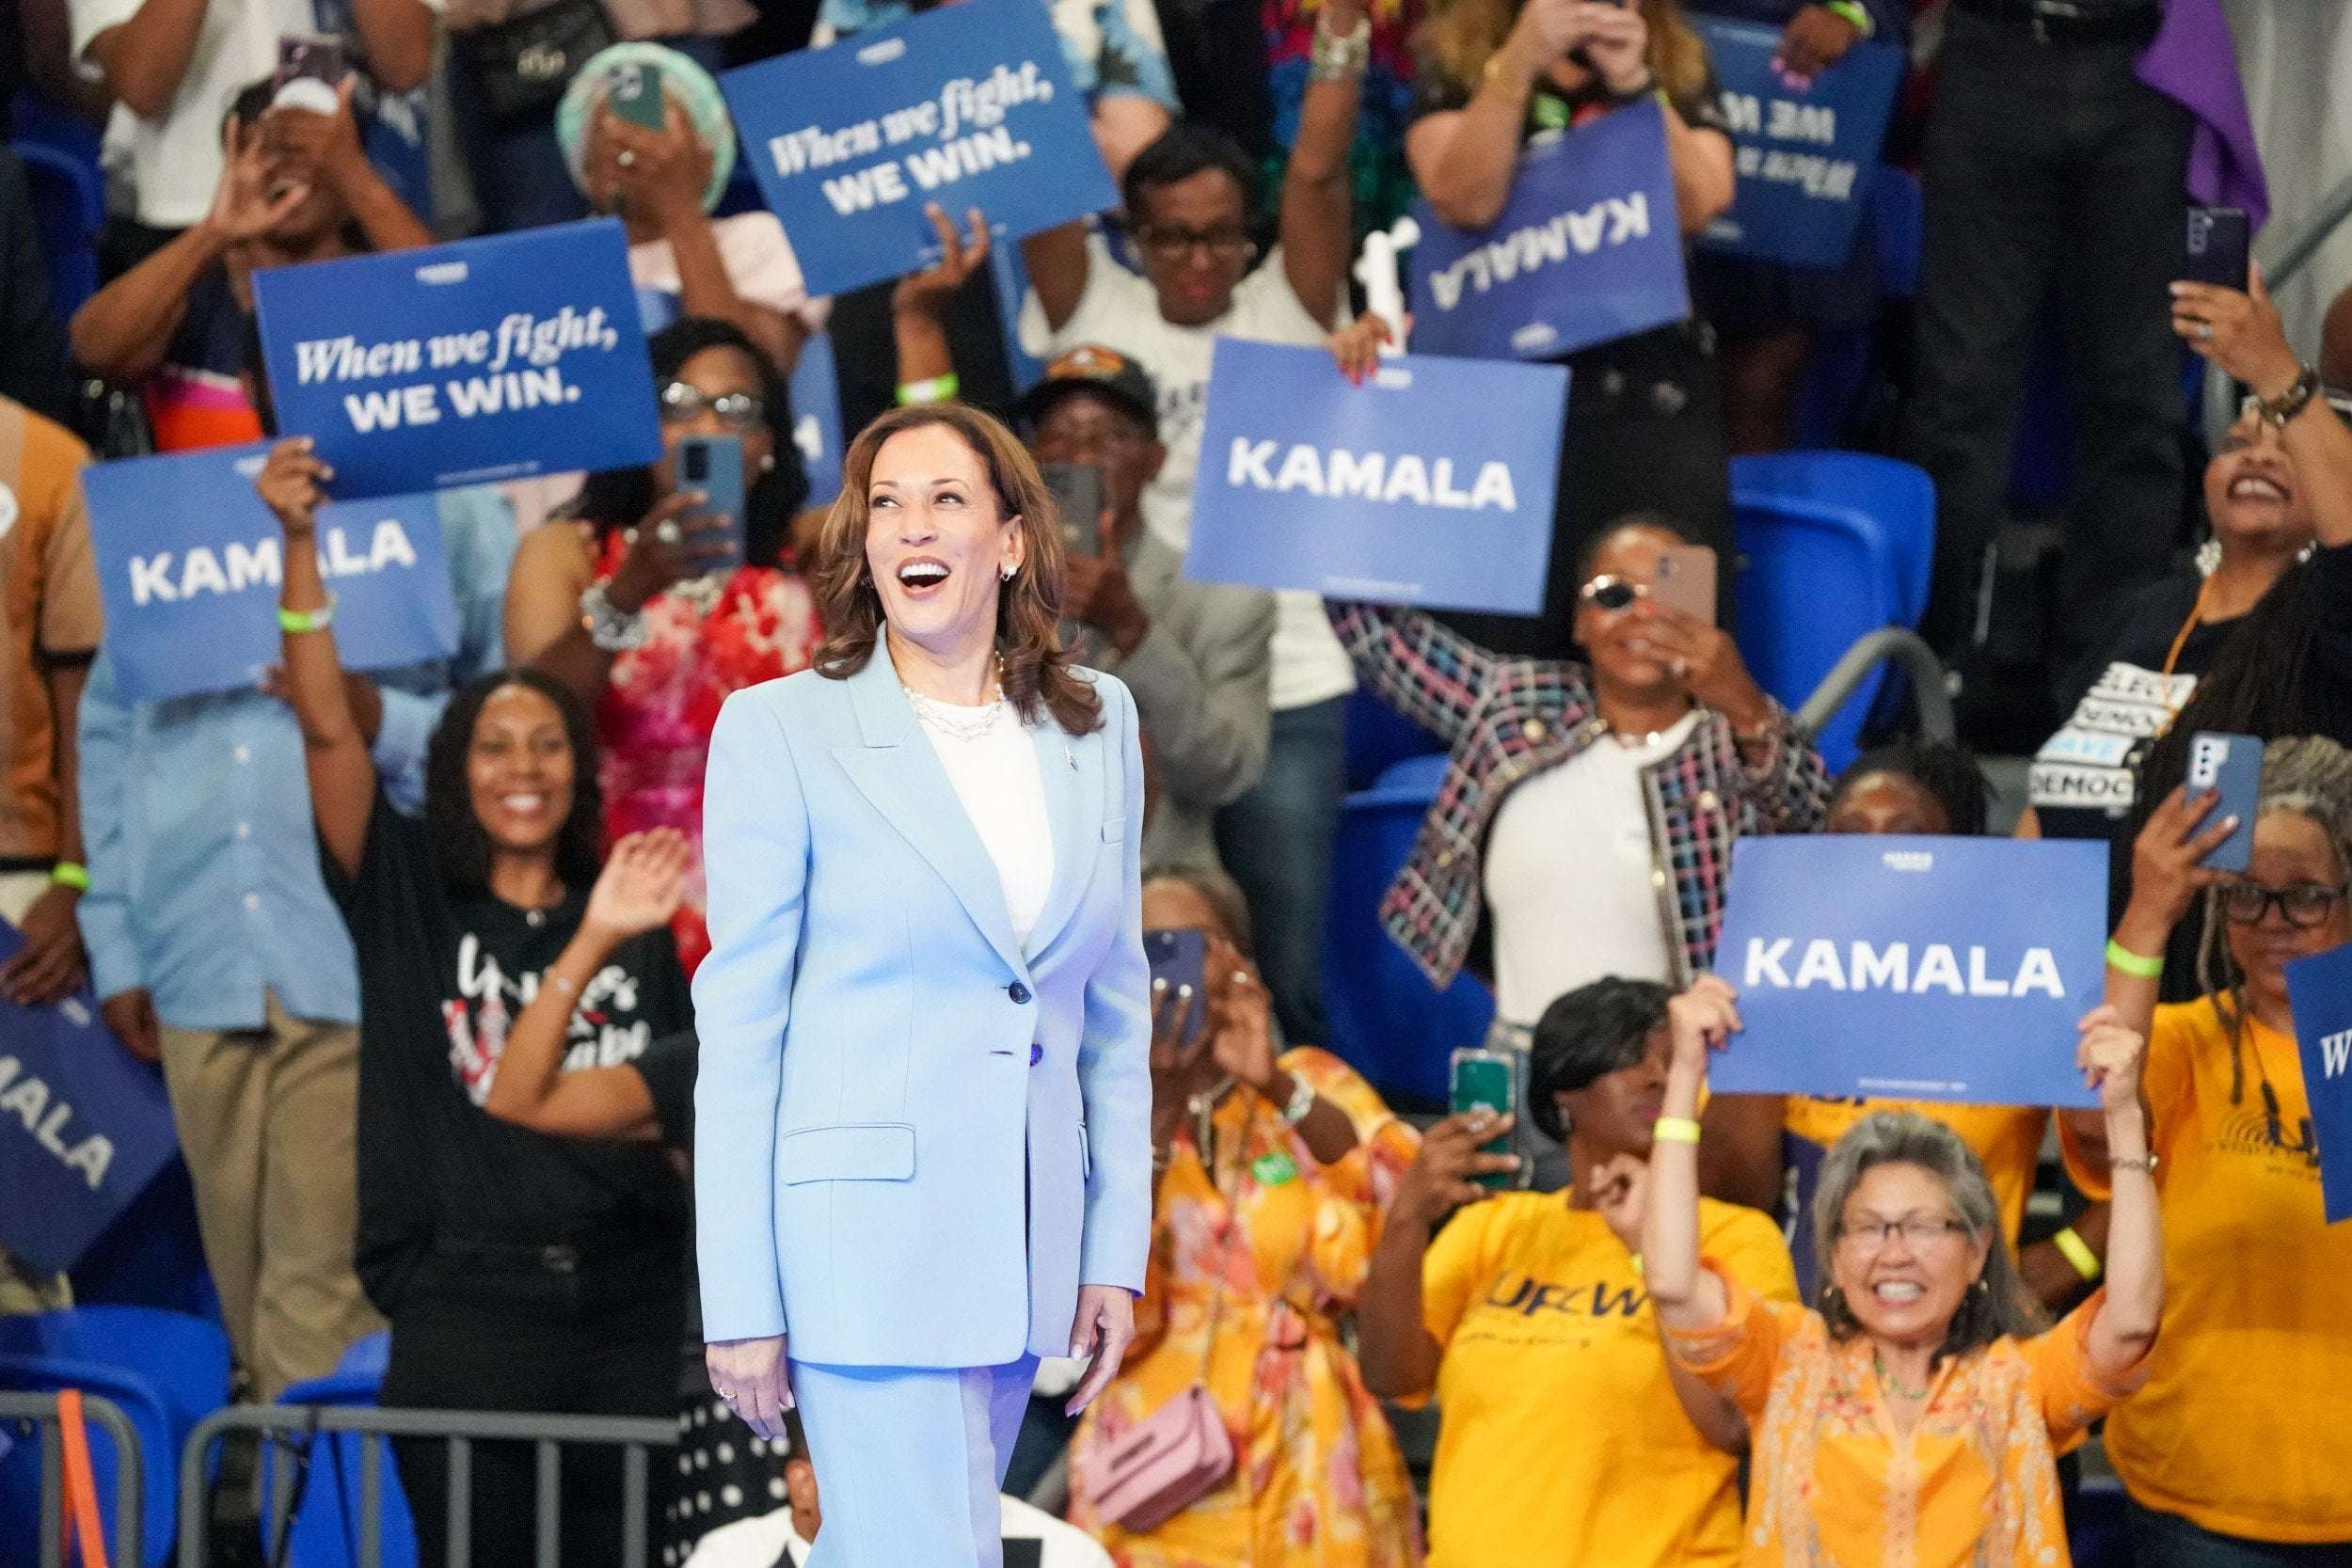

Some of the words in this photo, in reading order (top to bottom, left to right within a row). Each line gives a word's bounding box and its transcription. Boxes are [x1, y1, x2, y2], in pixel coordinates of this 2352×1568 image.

[770, 126, 881, 177] When
[882, 101, 939, 147] we
[939, 61, 1055, 141] fight,
[821, 162, 910, 216] WE
[906, 126, 1032, 188] WIN.
[1429, 192, 1651, 311] KAMALA
[296, 335, 421, 386] When
[427, 330, 490, 369] we
[488, 306, 618, 372] fight,
[343, 384, 442, 434] WE
[447, 366, 582, 418] WIN.
[1229, 436, 1518, 513] KAMALA
[129, 520, 418, 606] KAMLA
[1743, 936, 2066, 999] KAMALA
